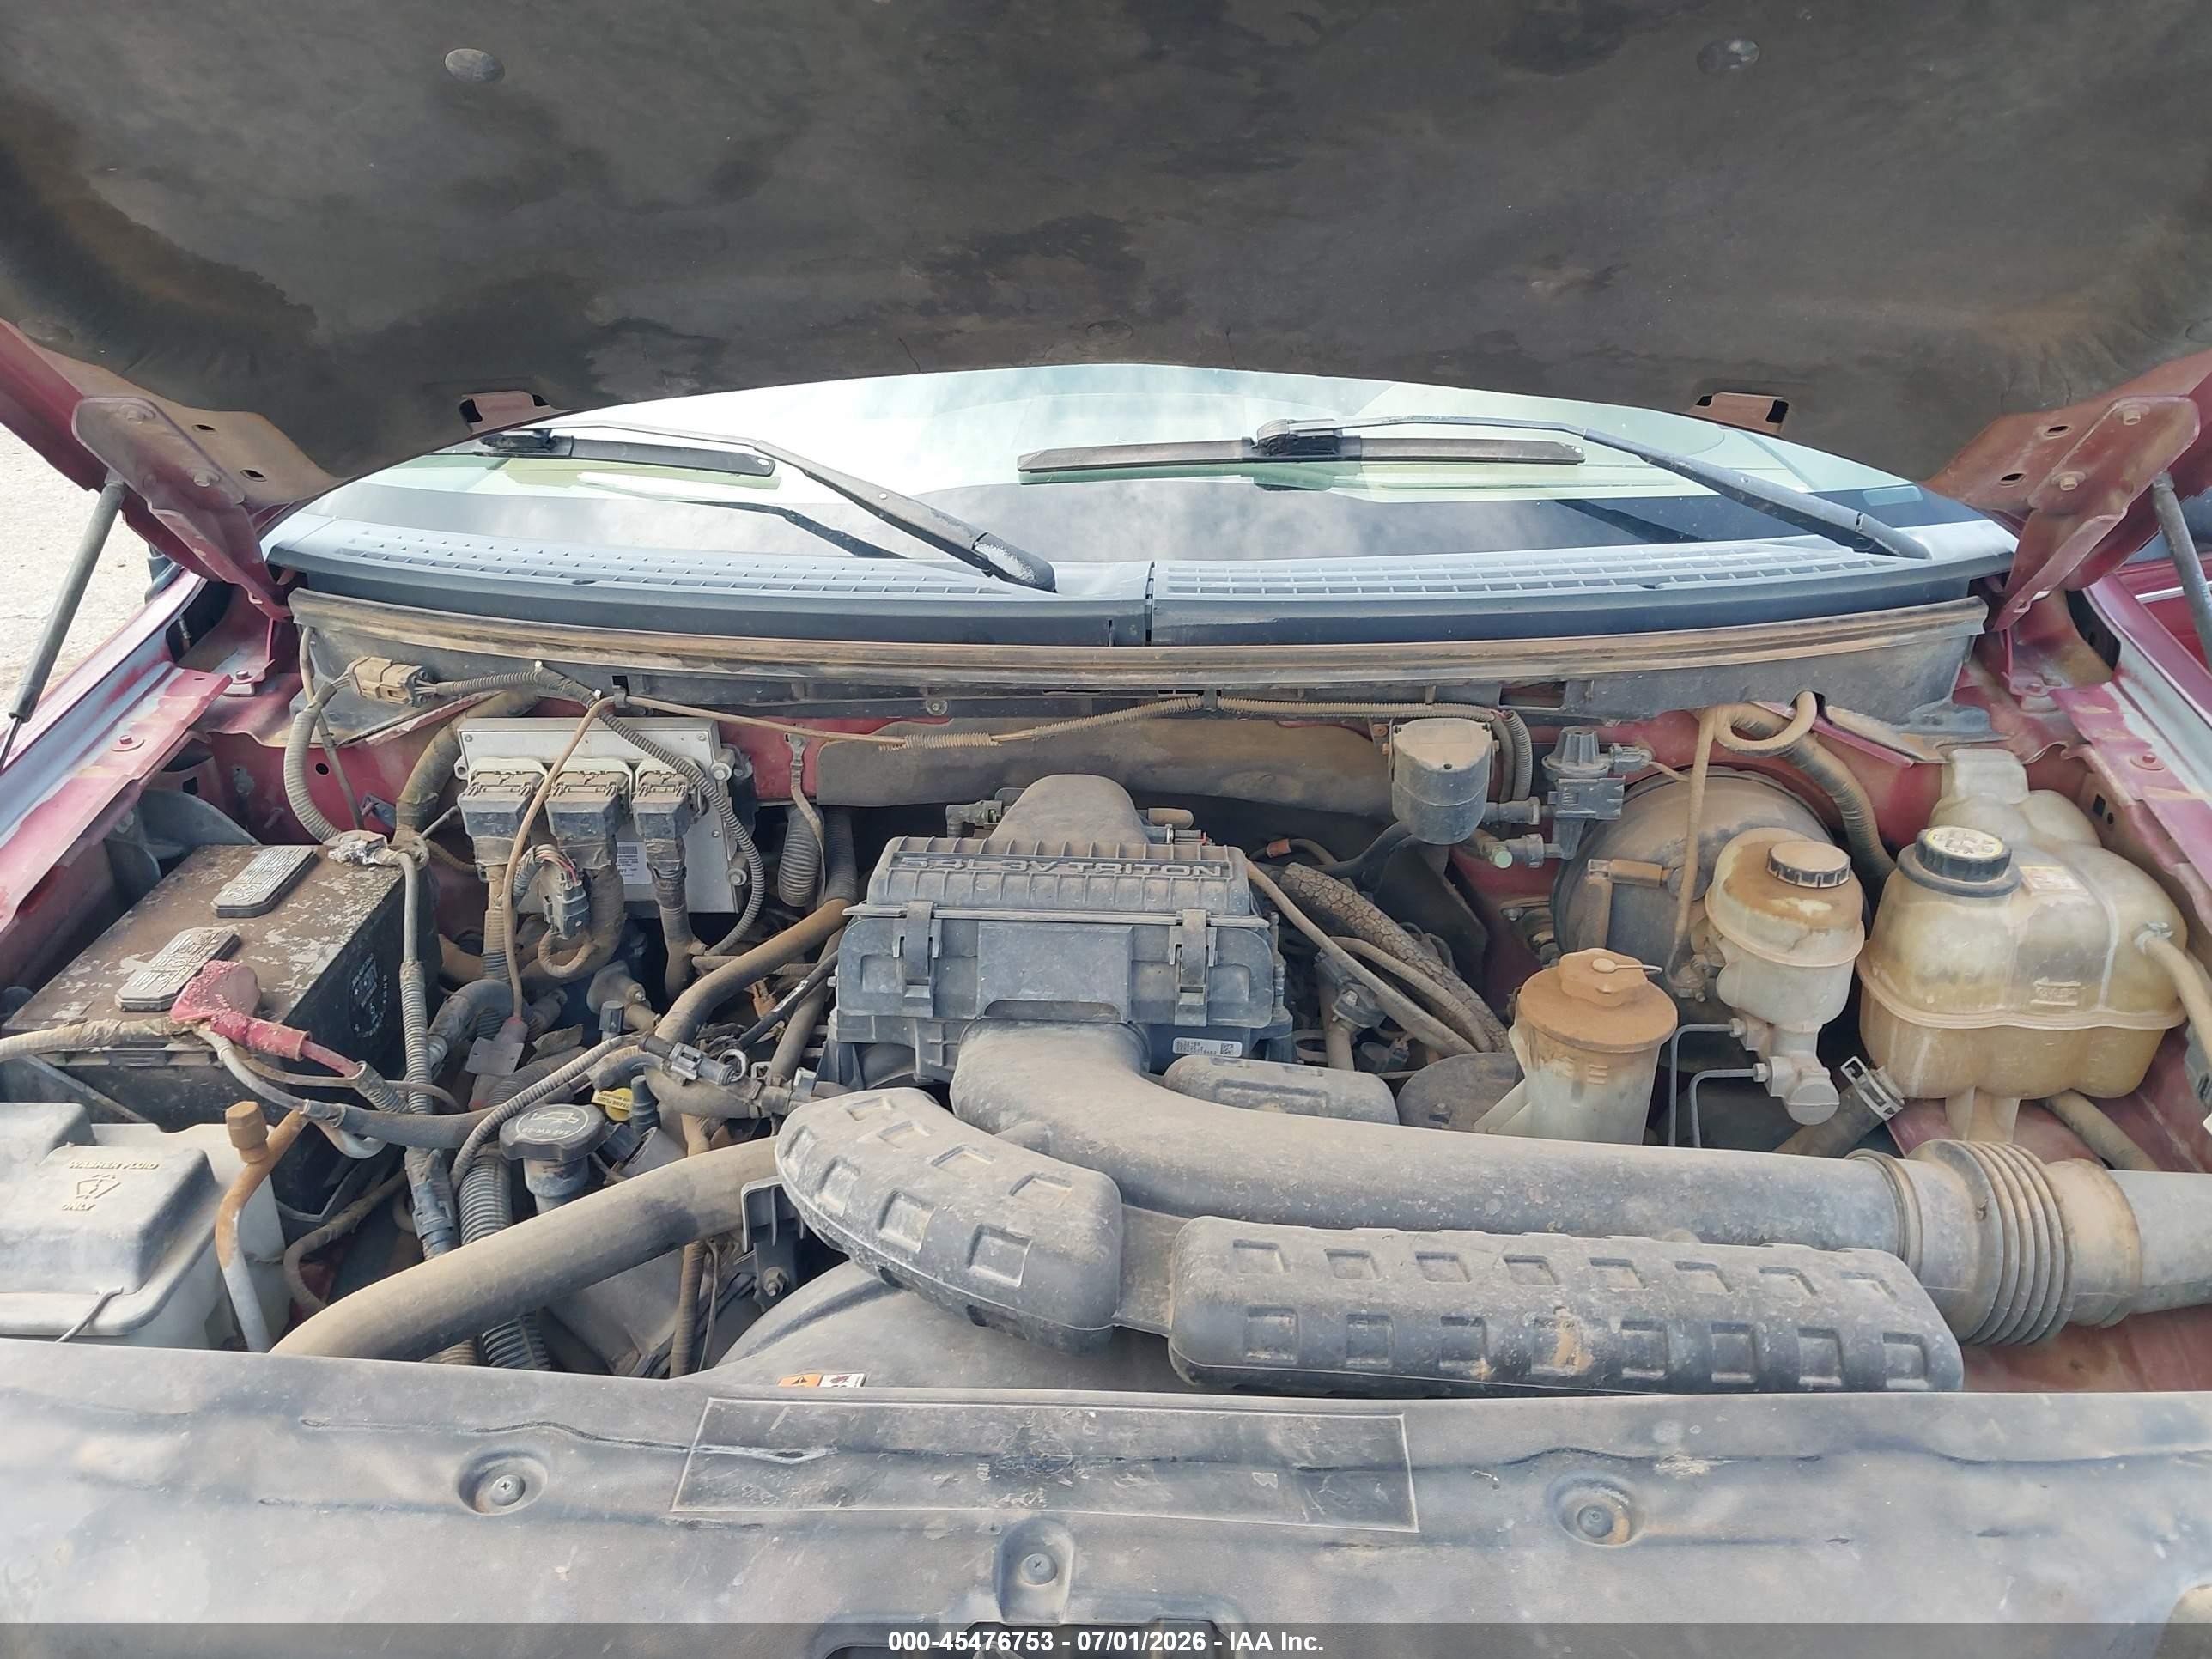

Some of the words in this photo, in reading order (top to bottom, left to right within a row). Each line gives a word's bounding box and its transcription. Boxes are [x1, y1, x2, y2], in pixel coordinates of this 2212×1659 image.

[901, 856, 989, 871] 5.4L
[1000, 860, 1058, 872] 3V
[1067, 861, 1221, 877] TRITON
[68, 1160, 122, 1170] WASHER
[61, 1202, 96, 1212] ONLY
